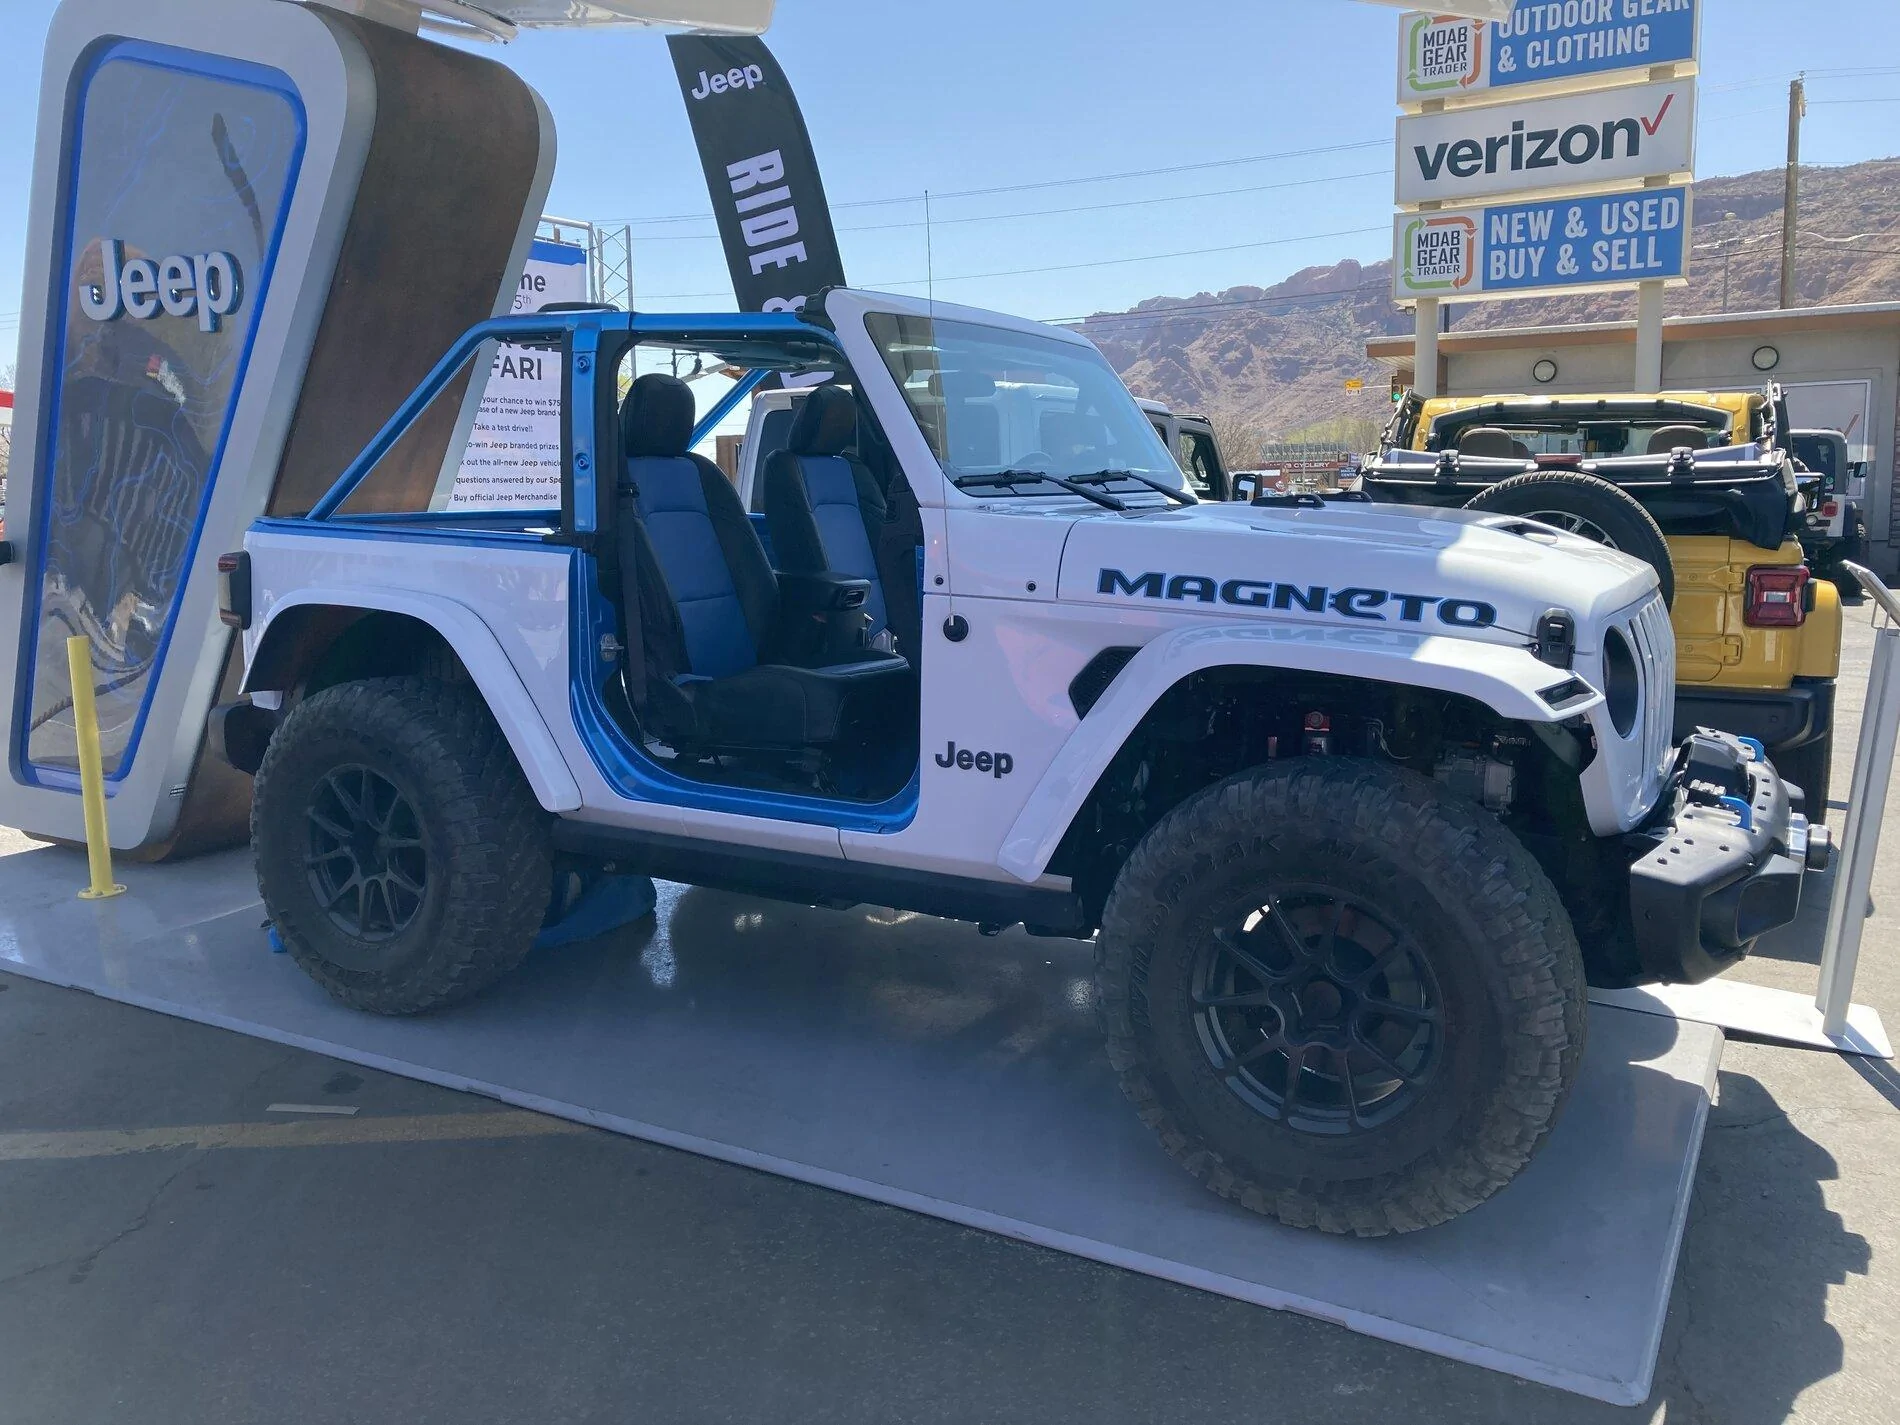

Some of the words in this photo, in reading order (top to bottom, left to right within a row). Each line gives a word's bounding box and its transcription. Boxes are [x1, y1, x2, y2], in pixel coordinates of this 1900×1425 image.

[1498, 0, 1613, 39] OUTDOOR
[1423, 26, 1468, 49] MOAB
[1497, 45, 1517, 73] &
[1527, 23, 1650, 69] CLOTHING
[1423, 43, 1468, 67] GEAR
[1423, 62, 1467, 76] TRADER
[691, 64, 764, 100] Jeep
[1413, 117, 1641, 181] verizon
[726, 149, 808, 276] RIDE
[1490, 208, 1555, 246] NEW
[1564, 206, 1588, 238] &
[1600, 196, 1680, 235] USED
[1417, 230, 1460, 249] MOAB
[1417, 247, 1460, 267] GEAR
[1489, 247, 1546, 281] BUY
[1556, 243, 1580, 275] &
[1591, 235, 1663, 273] SELL
[1417, 264, 1460, 276] TRADER
[79, 239, 243, 332] Jeep
[491, 406, 499, 414] of
[520, 408, 536, 416] Jeep
[538, 408, 557, 416] brand
[499, 397, 524, 405] chance
[534, 398, 547, 406] win
[473, 423, 490, 431] Take
[497, 424, 511, 432] test
[511, 425, 534, 433] drive!!
[489, 442, 508, 450] Jeep
[509, 442, 538, 450] branded
[539, 442, 559, 451] prizes
[479, 458, 491, 466] the
[520, 459, 538, 467] Jeep
[455, 476, 490, 485] questions
[491, 476, 524, 484] answered
[525, 476, 534, 485] by
[453, 494, 468, 503] Buy
[469, 493, 495, 501] official
[496, 494, 513, 502] Jeep
[514, 493, 558, 501] Merchandise
[935, 741, 1014, 779] Jeep
